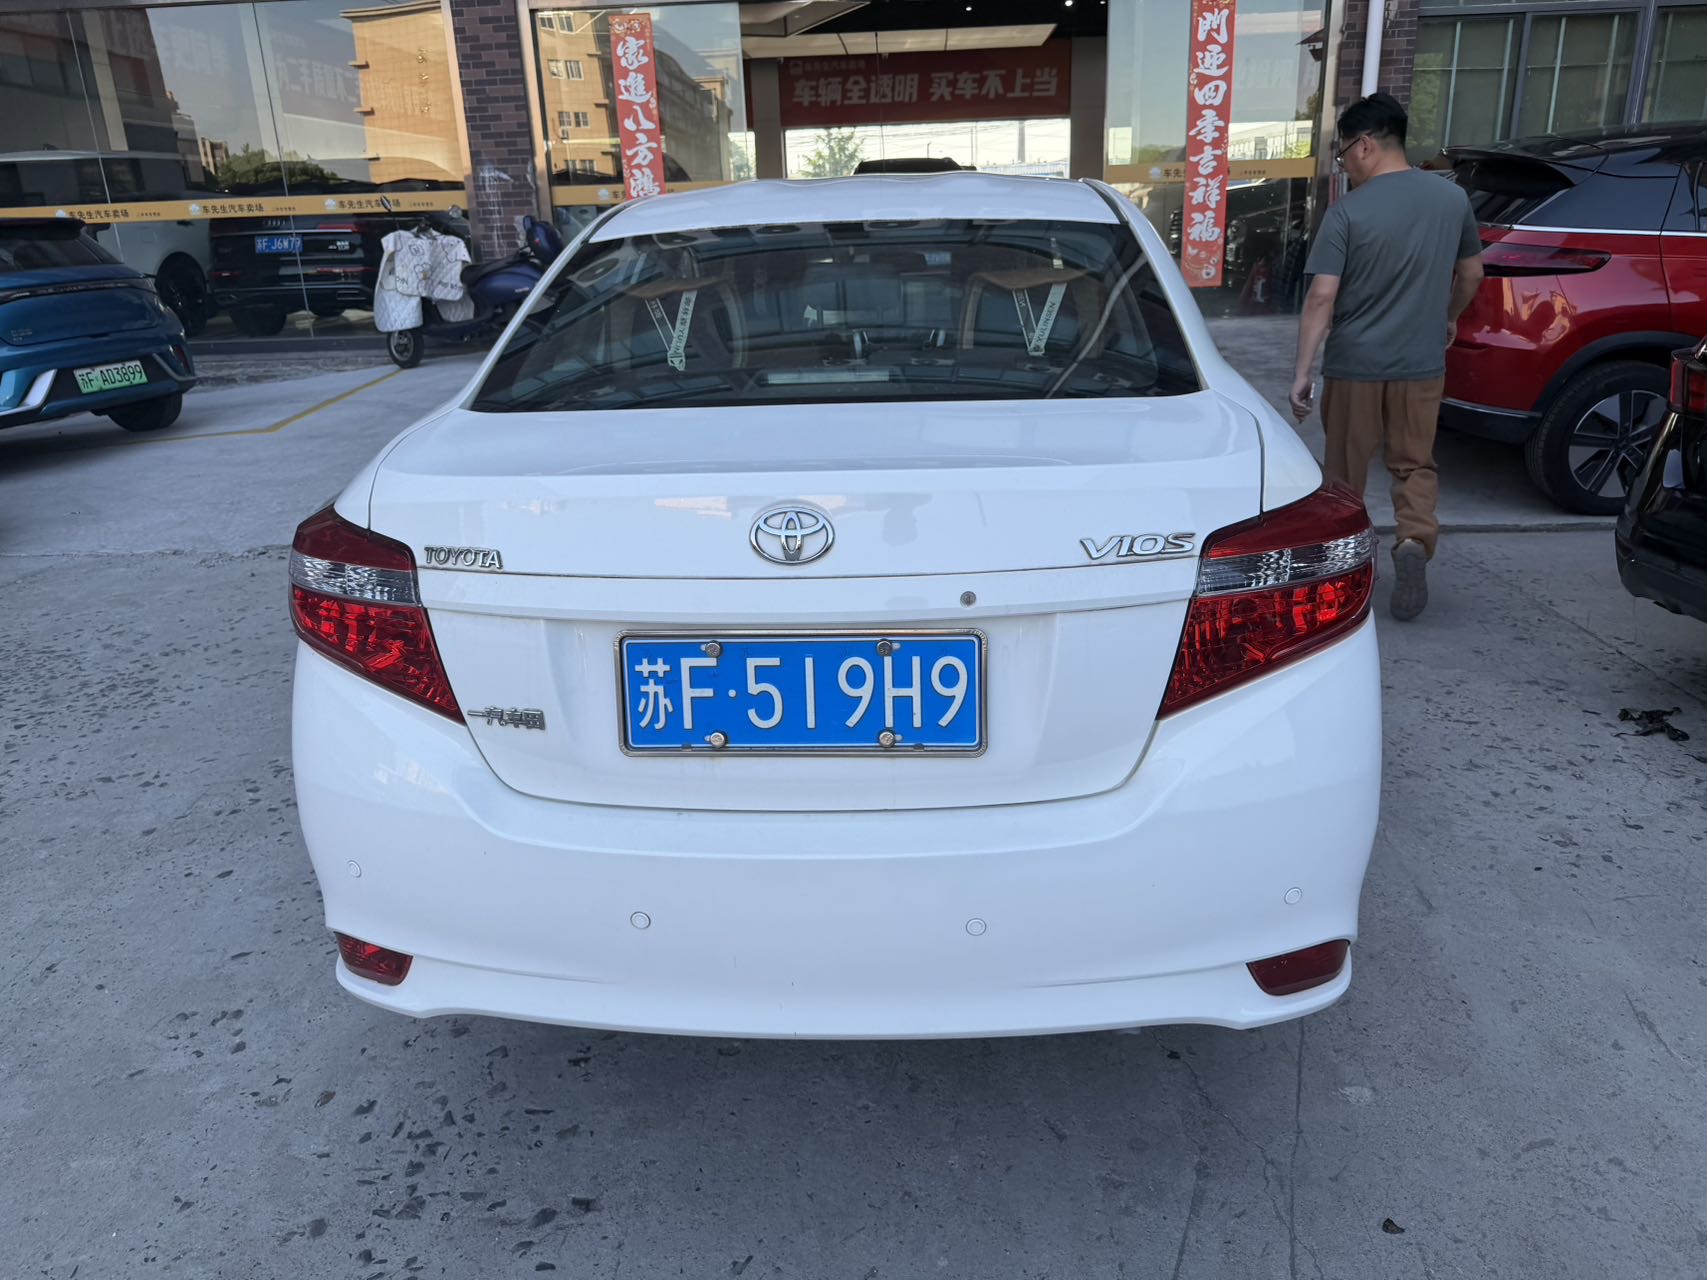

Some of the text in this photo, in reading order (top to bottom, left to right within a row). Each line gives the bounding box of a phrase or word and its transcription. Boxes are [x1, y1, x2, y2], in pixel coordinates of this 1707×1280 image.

[792, 66, 1058, 108] 车辆全透明 买车不上当
[202, 203, 264, 214] 车先生汽车卖场
[424, 546, 503, 570] TOYOTA
[1080, 533, 1195, 560] VIOS
[635, 655, 968, 730] 苏F·519H9
